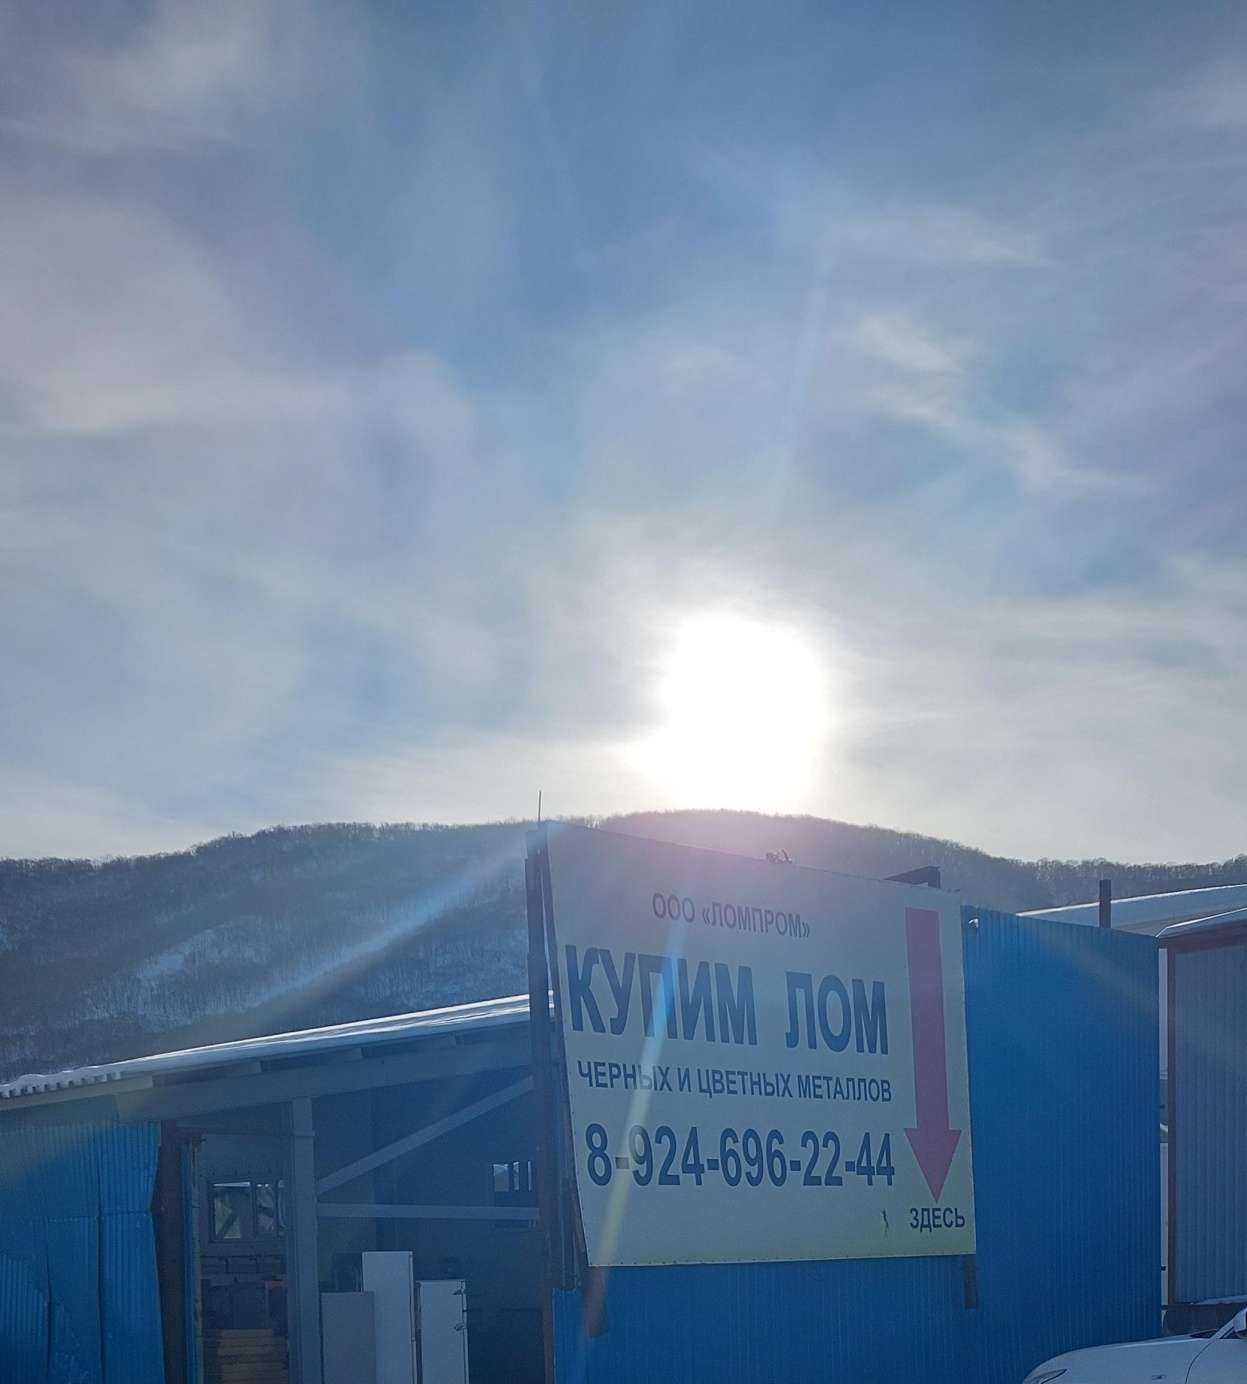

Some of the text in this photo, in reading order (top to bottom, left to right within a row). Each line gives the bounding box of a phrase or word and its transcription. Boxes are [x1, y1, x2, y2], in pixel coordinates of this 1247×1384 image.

[652, 893, 811, 938] ООО «ЛОМПРОМ»
[565, 944, 889, 1055] КУПИМ ЛОМ
[577, 1060, 892, 1102] ЧЕРНЫХ И ЦВЕТНЫХ МЕТАЛЛОВ
[585, 1122, 895, 1187] 8-924-696-22-44
[909, 1207, 966, 1231] ЗДЕСЬ
